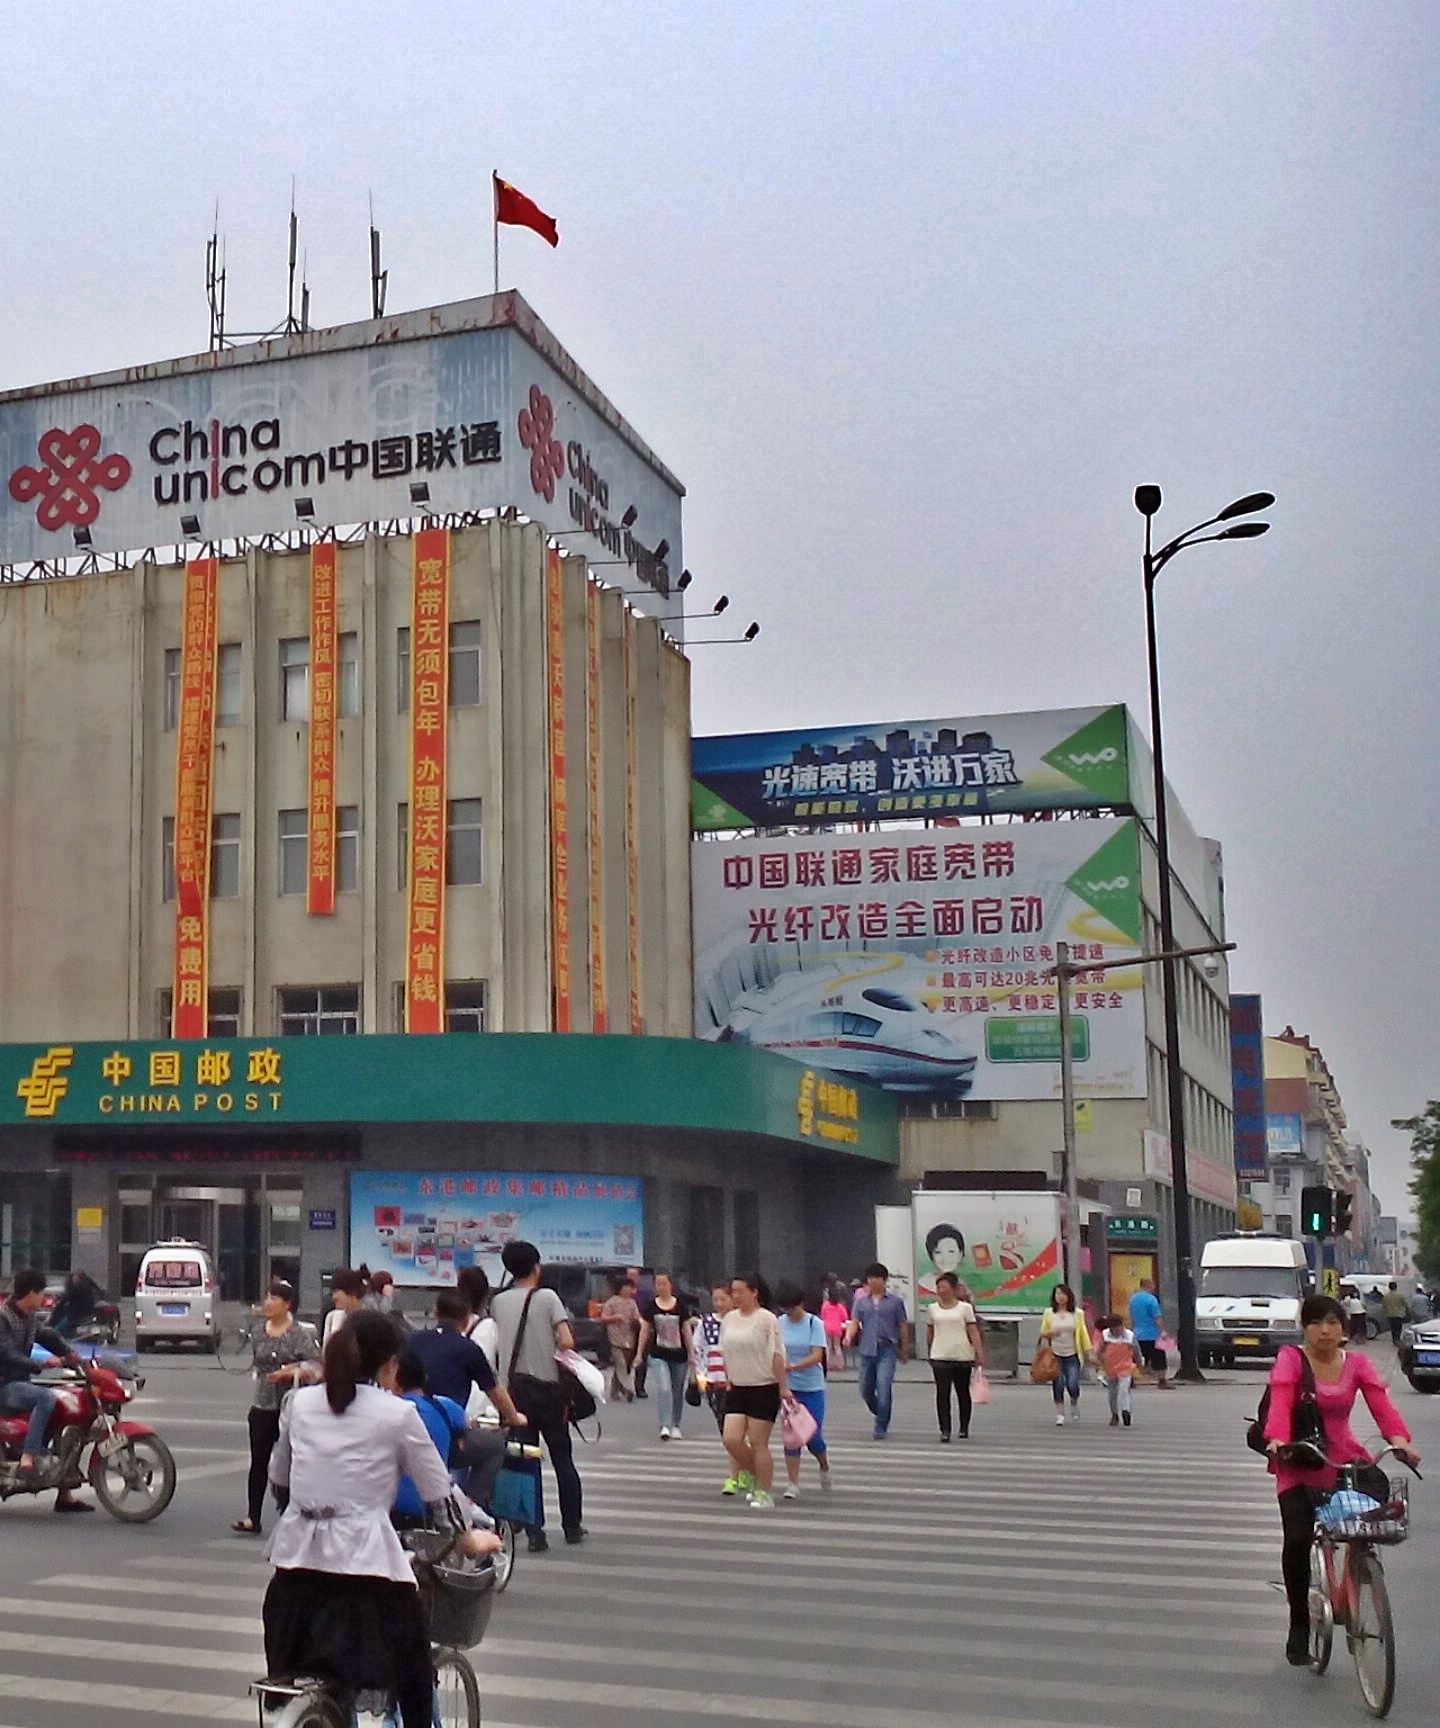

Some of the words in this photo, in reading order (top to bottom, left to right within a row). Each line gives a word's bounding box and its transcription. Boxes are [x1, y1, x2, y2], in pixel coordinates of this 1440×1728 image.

[149, 416, 281, 466] China
[153, 451, 325, 507] unicom
[327, 419, 503, 481] 中国联通
[567, 439, 609, 511] China
[314, 564, 332, 665] 改进工作作风
[415, 557, 444, 738] 宽带无须包年
[313, 671, 332, 774] 密切联系群众
[761, 759, 878, 800] 光速宽带
[891, 751, 1020, 791] 沃进万家
[722, 840, 1017, 892] 中国联通家庭宽带
[748, 894, 1045, 946] 光纤改造全面启动
[941, 942, 1105, 966] 光纤改造小区免提速
[941, 966, 1107, 990] 最高可达20兆光宽带
[101, 1047, 282, 1087] 中国邮政
[98, 1094, 181, 1113] CHINA
[193, 1093, 283, 1112] POST
